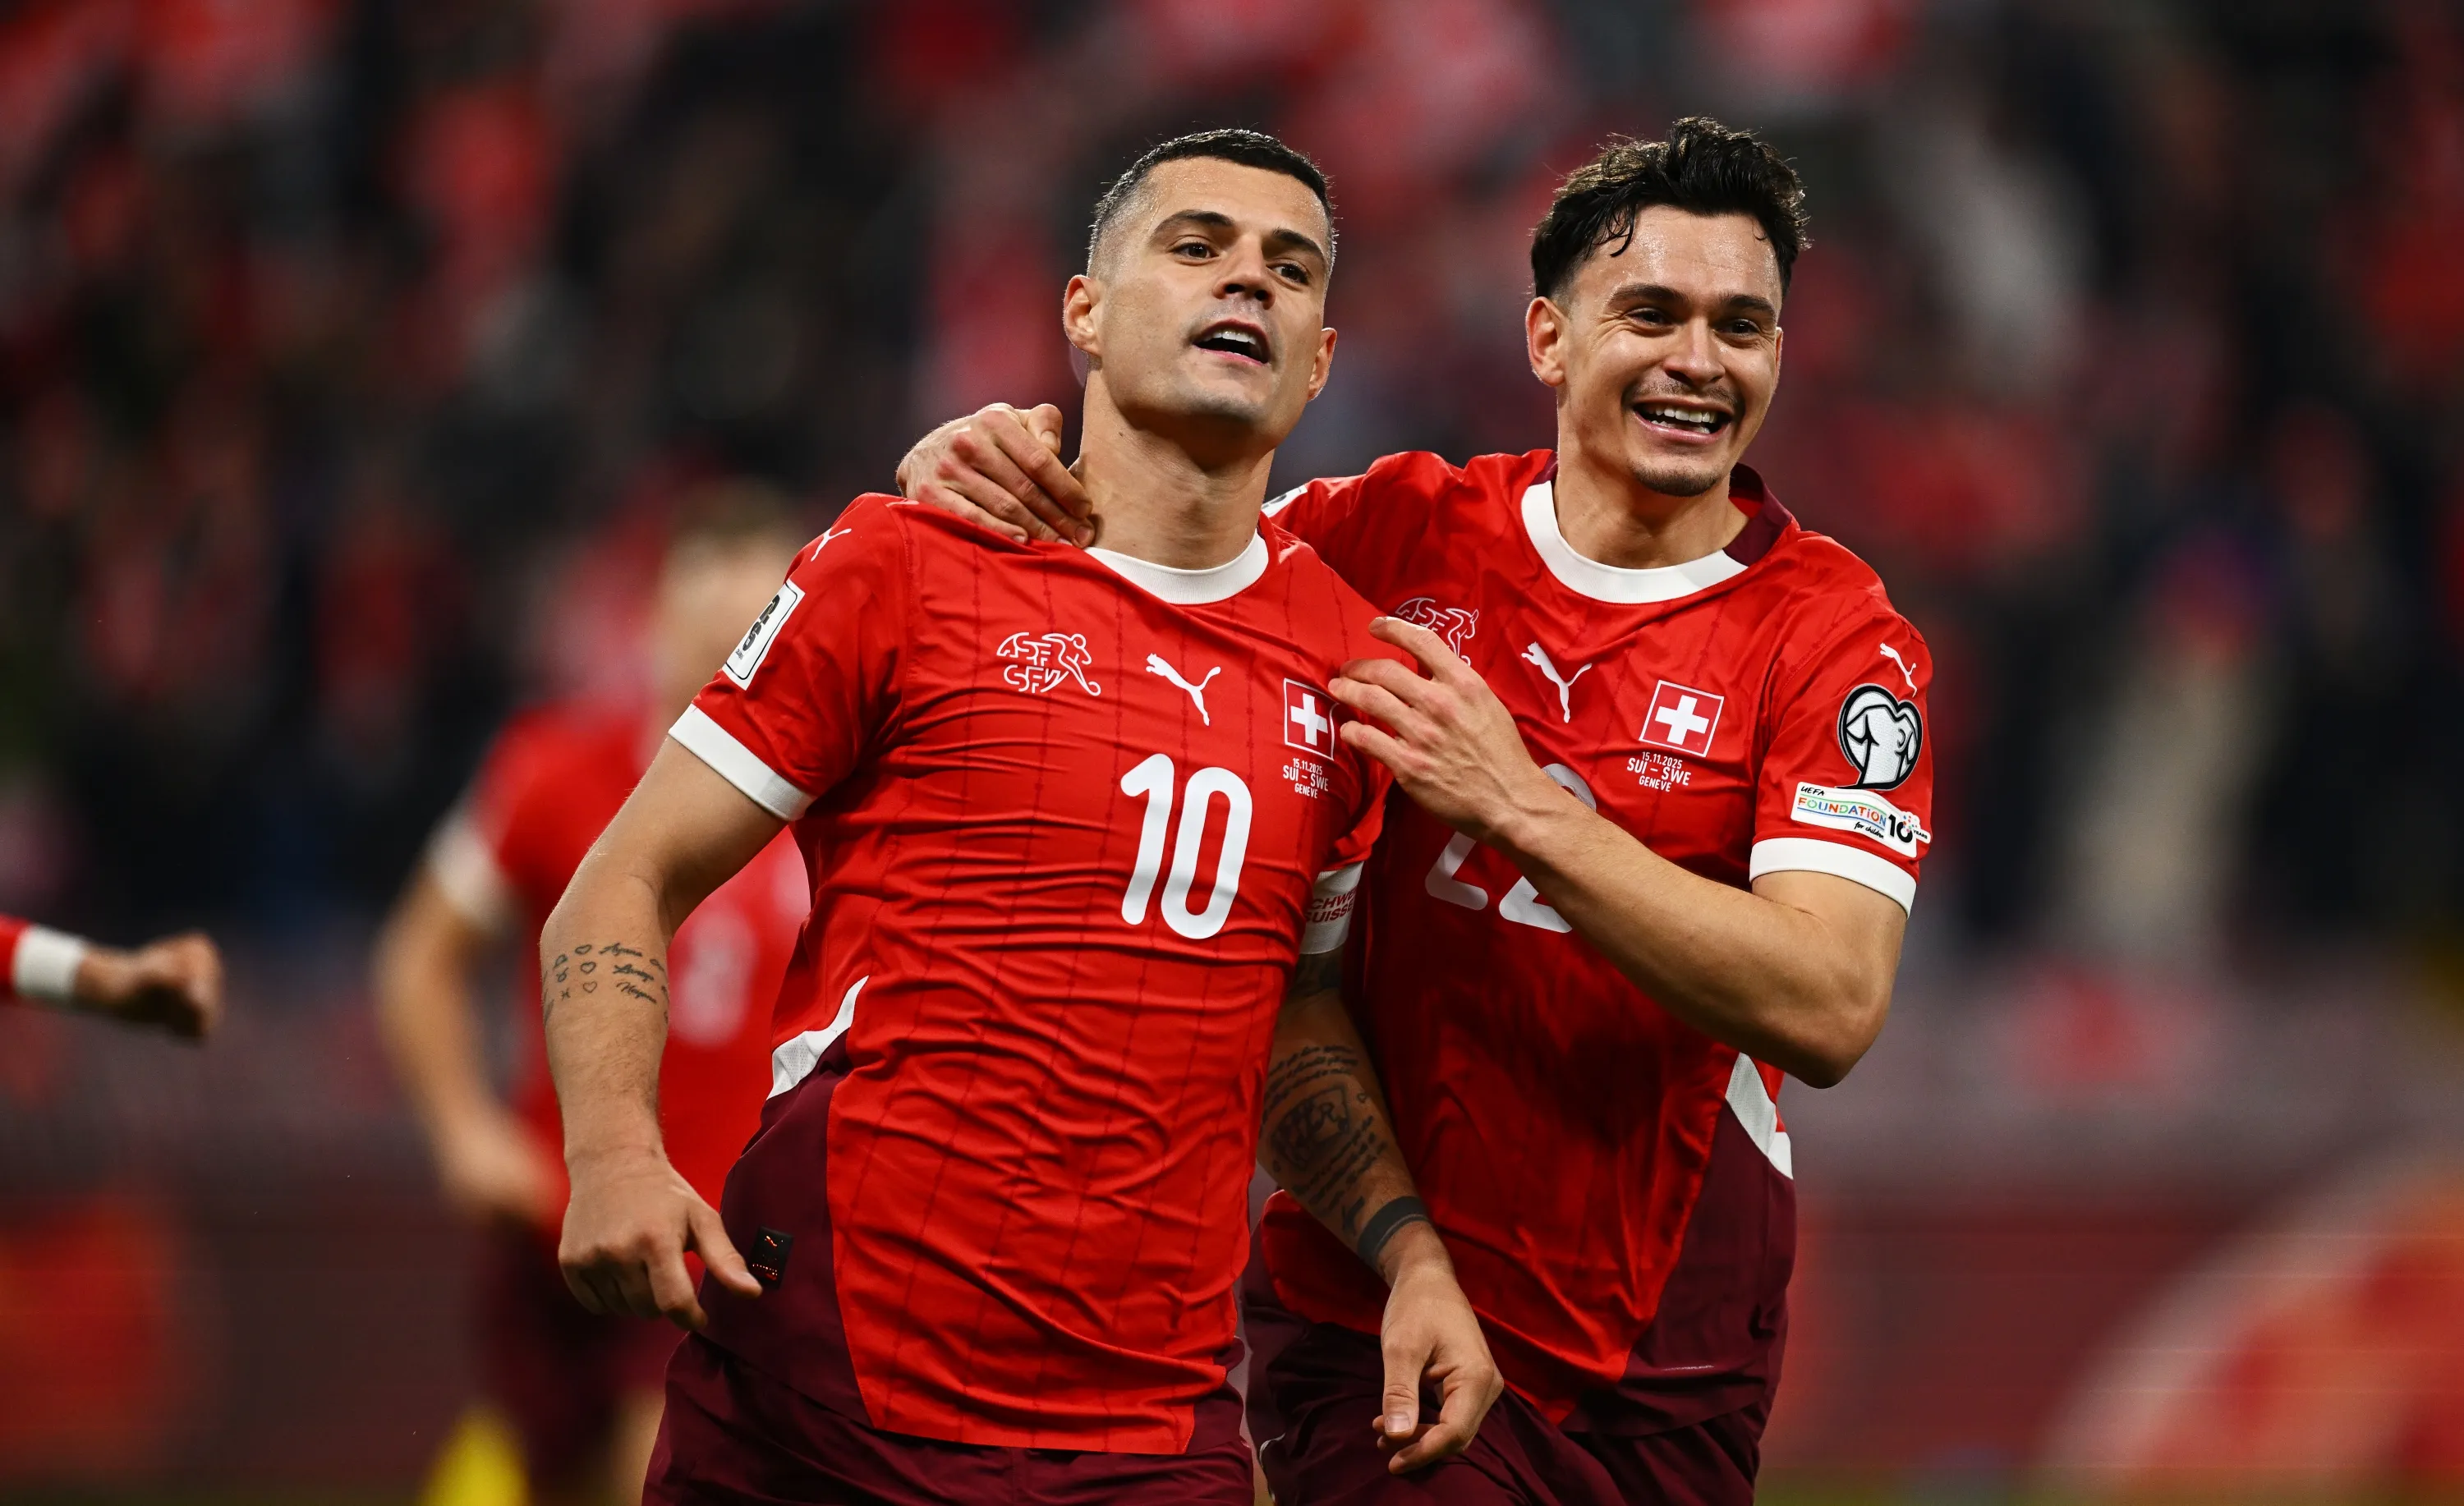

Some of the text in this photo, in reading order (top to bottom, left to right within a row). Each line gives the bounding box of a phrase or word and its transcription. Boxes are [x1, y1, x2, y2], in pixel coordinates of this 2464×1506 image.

[1292, 757, 1323, 776] 15.11.2025
[1642, 751, 1683, 769] 15.11.2025
[1283, 764, 1299, 782] SUI
[1310, 773, 1329, 792] SWE
[1626, 757, 1648, 774] SUI
[1661, 766, 1692, 786] SWE
[1294, 783, 1318, 799] GENEVE
[1639, 775, 1672, 792] GENEVE
[1800, 786, 1825, 797] UEFA
[1854, 821, 1864, 830] for
[1120, 754, 1253, 939] 10
